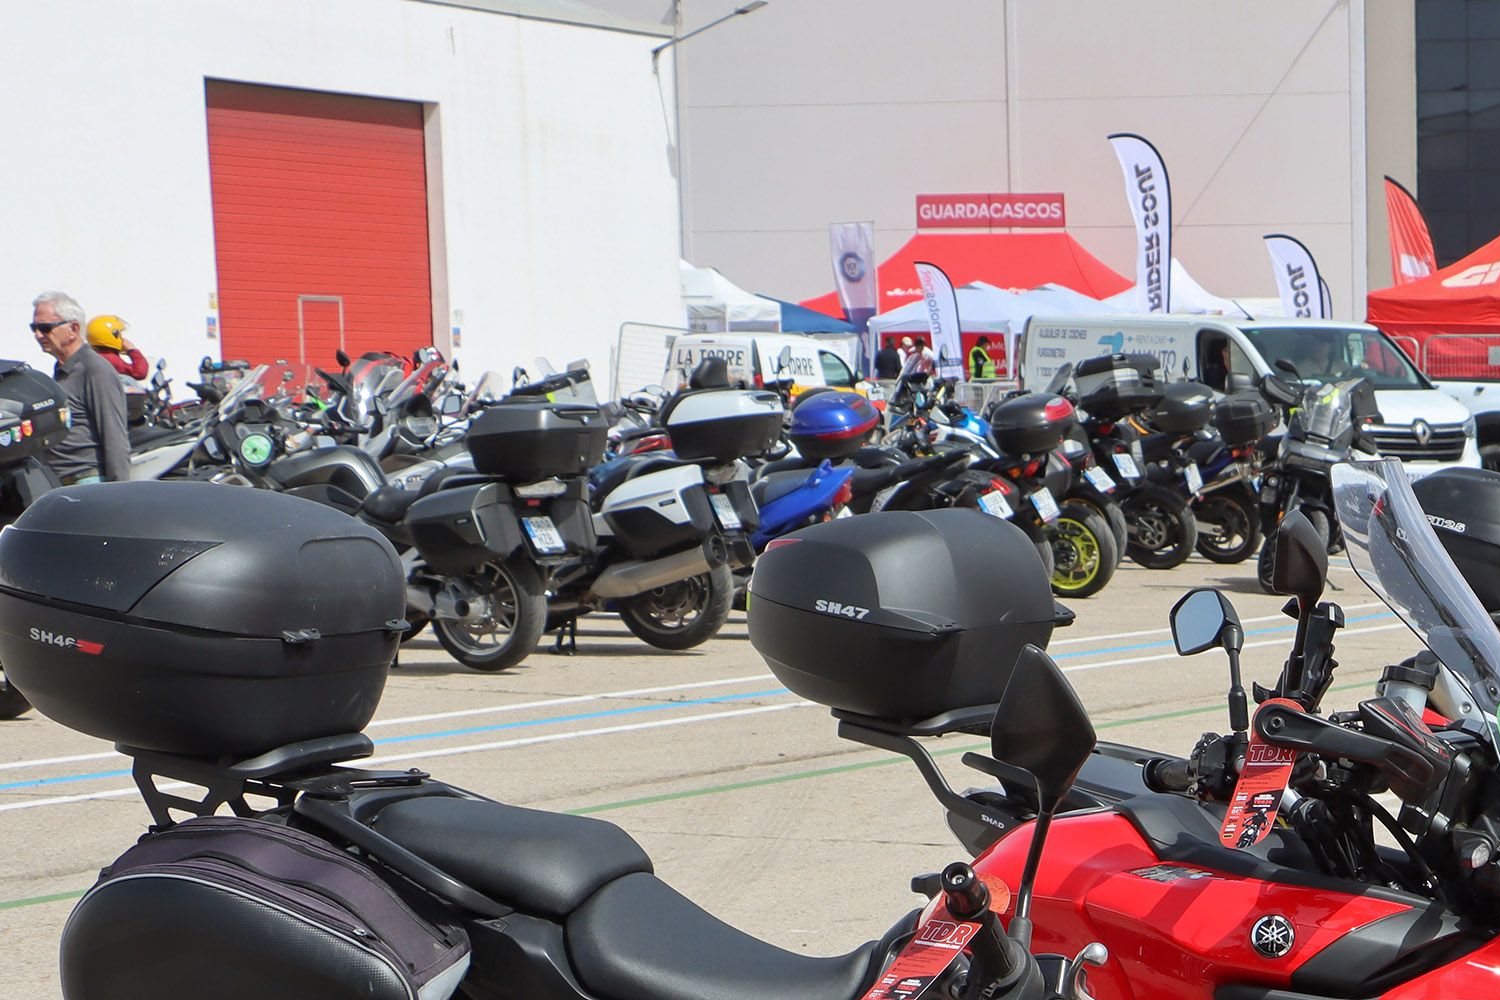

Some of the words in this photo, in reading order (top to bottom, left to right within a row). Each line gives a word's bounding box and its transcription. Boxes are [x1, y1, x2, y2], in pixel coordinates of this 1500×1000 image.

[919, 202, 1062, 219] GUARDACASCOS
[677, 349, 693, 365] LA
[815, 599, 870, 620] SH47
[1250, 744, 1294, 763] TDR
[981, 813, 1005, 829] SHAD
[921, 919, 973, 945] TDR
